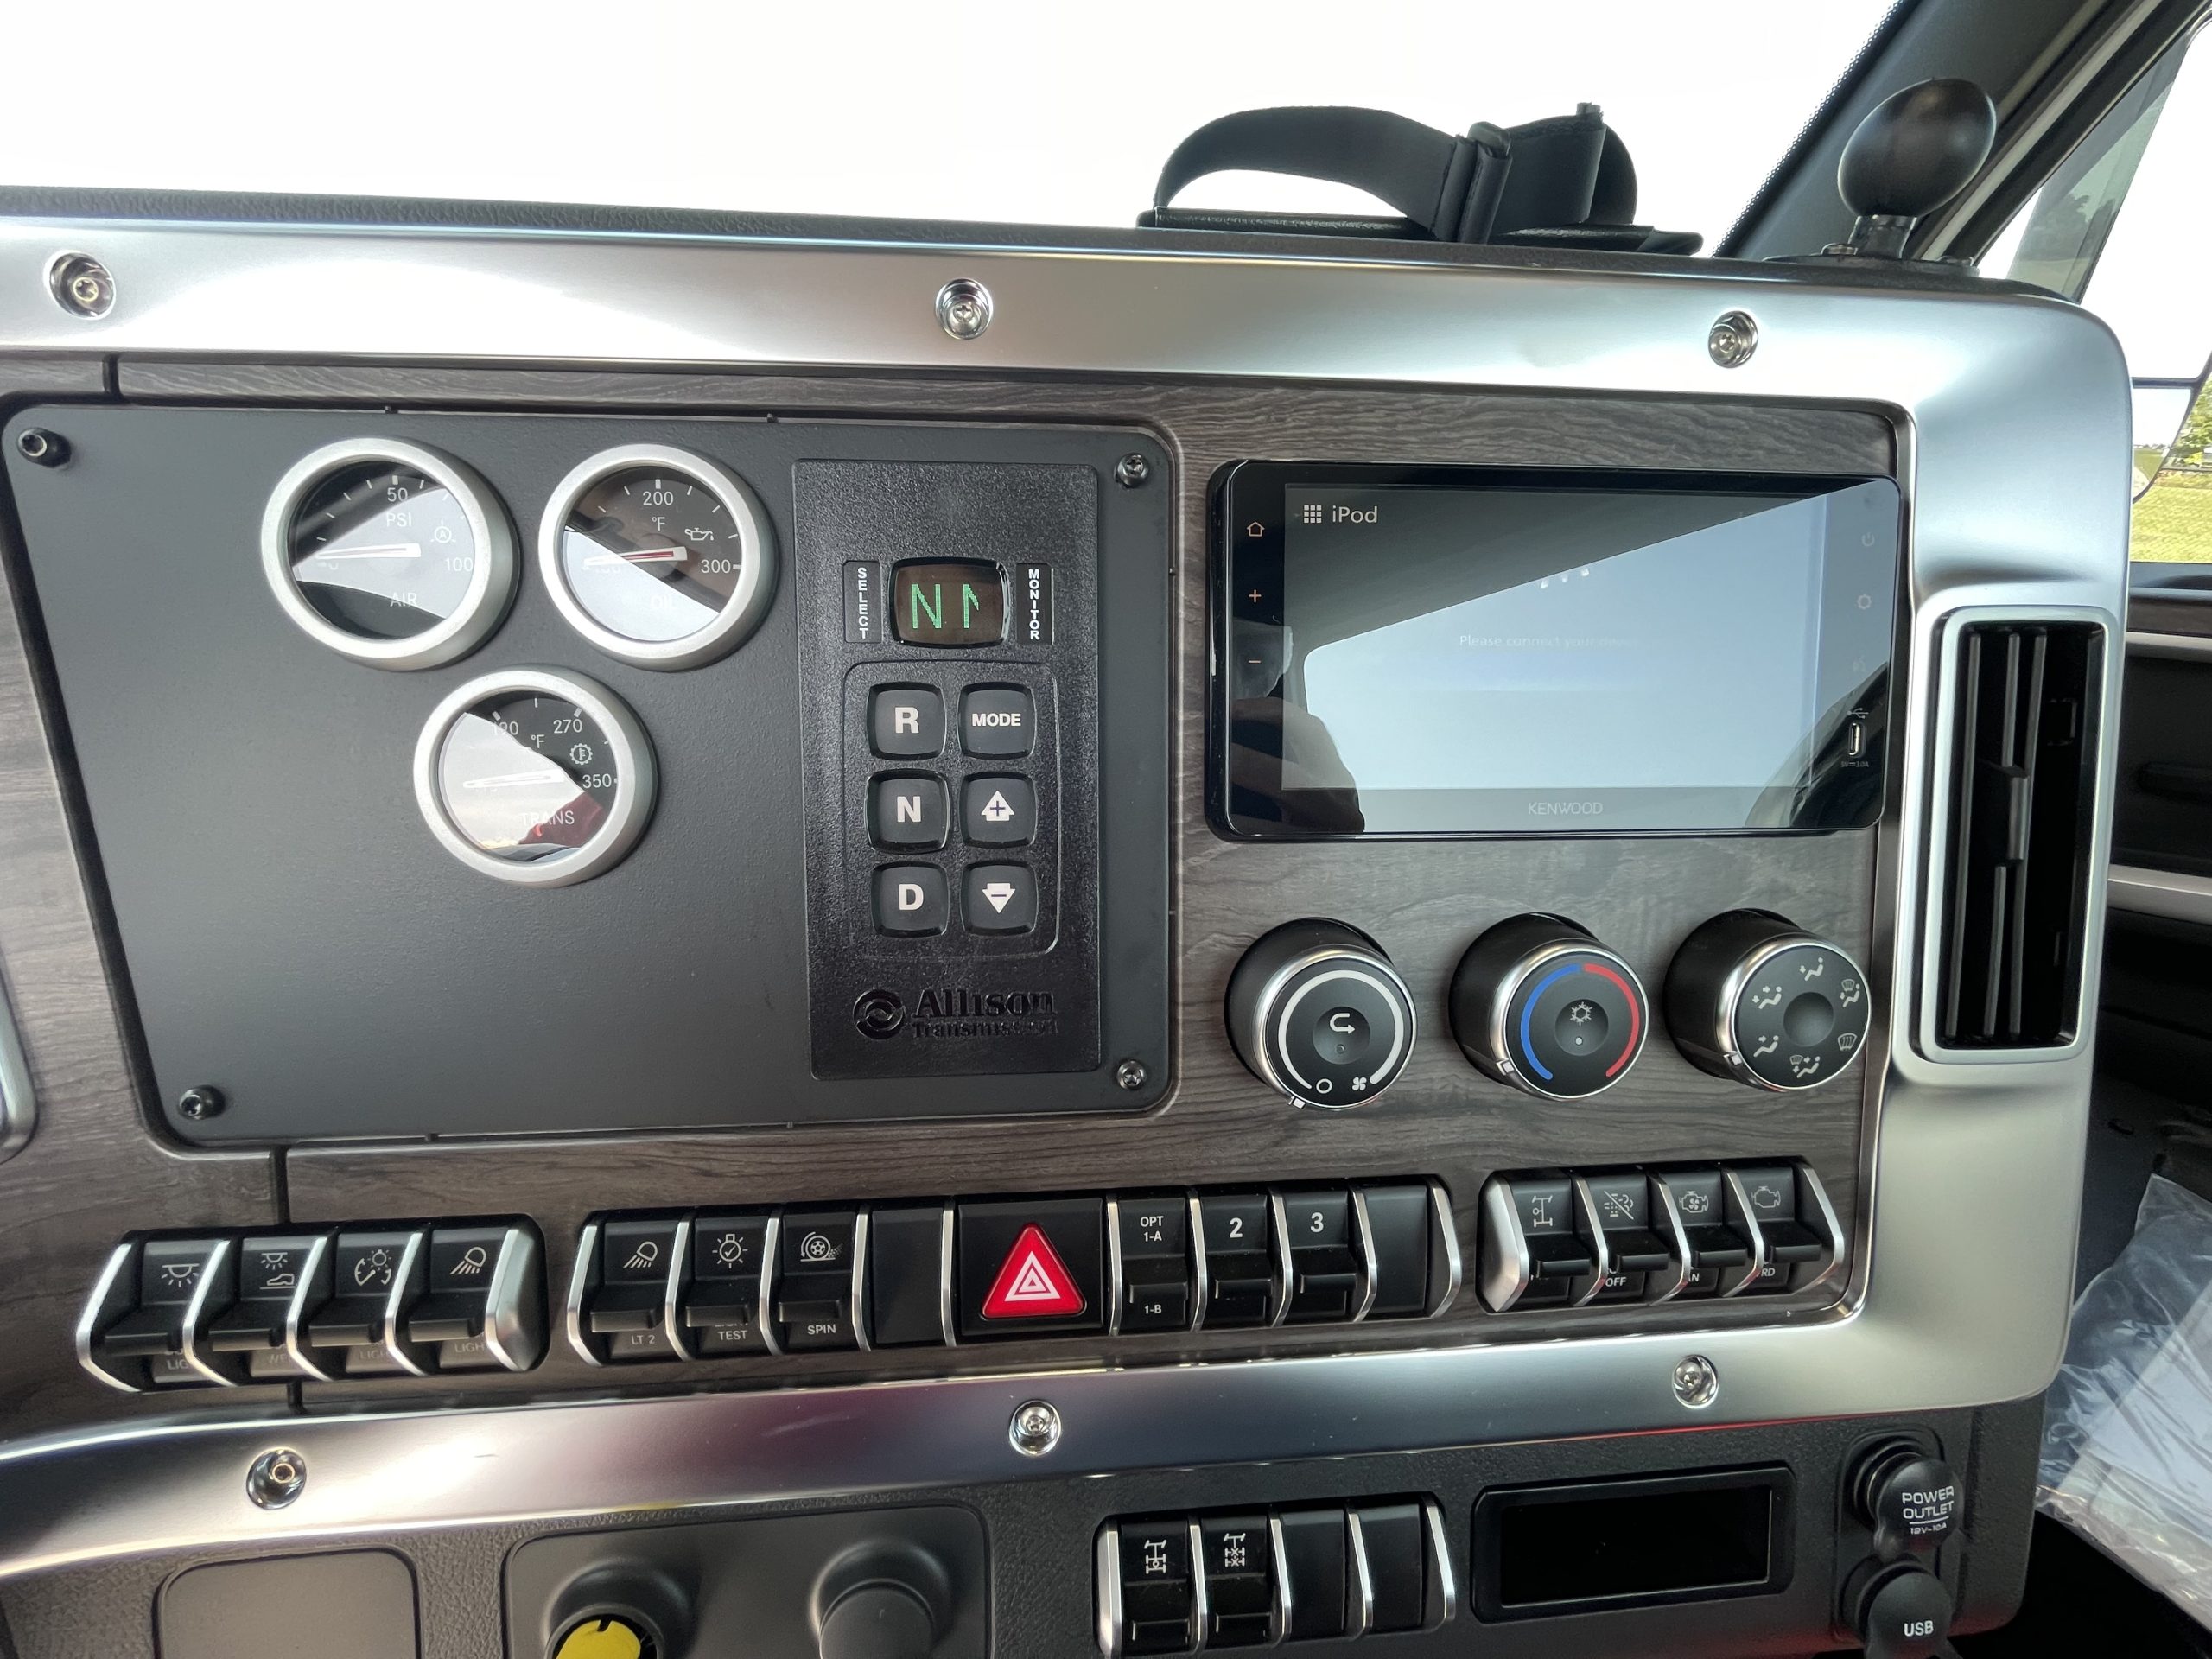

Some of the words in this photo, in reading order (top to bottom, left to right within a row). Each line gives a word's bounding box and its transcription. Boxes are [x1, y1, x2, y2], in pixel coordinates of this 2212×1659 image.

[387, 488, 408, 502] 50
[643, 492, 674, 505] 200
[386, 512, 412, 527] PSI
[1332, 505, 1377, 523] iPod
[444, 556, 474, 572] 100
[701, 559, 731, 574] 300
[390, 593, 418, 607] AIR
[857, 567, 868, 639] SELECT
[1028, 569, 1040, 640] MONITOR
[1459, 635, 1502, 647] Please
[553, 719, 582, 734] 270
[894, 706, 919, 734] R
[972, 713, 1021, 727] MODE
[582, 773, 612, 788] 350
[897, 796, 922, 823] N
[1528, 802, 1604, 815] KENWOOD
[521, 810, 575, 825] TRANS
[899, 883, 925, 911] D
[911, 988, 1058, 1018] Allison
[1140, 1215, 1164, 1228] OPT
[1229, 1217, 1243, 1238] 2
[1310, 1212, 1324, 1233] 3
[1143, 1230, 1162, 1243] 1-A
[1605, 1276, 1626, 1287] OFF
[1145, 1304, 1162, 1314] 1-B
[717, 1330, 748, 1341] TEST
[807, 1324, 836, 1335] SPIN
[631, 1335, 643, 1345] LT
[648, 1334, 656, 1344] 2
[454, 1343, 485, 1353] LIGH
[167, 1359, 189, 1370] LIG
[1902, 1485, 1955, 1504] POWER
[1903, 1500, 1955, 1519] OUTLET
[1904, 1620, 1935, 1637] USB
